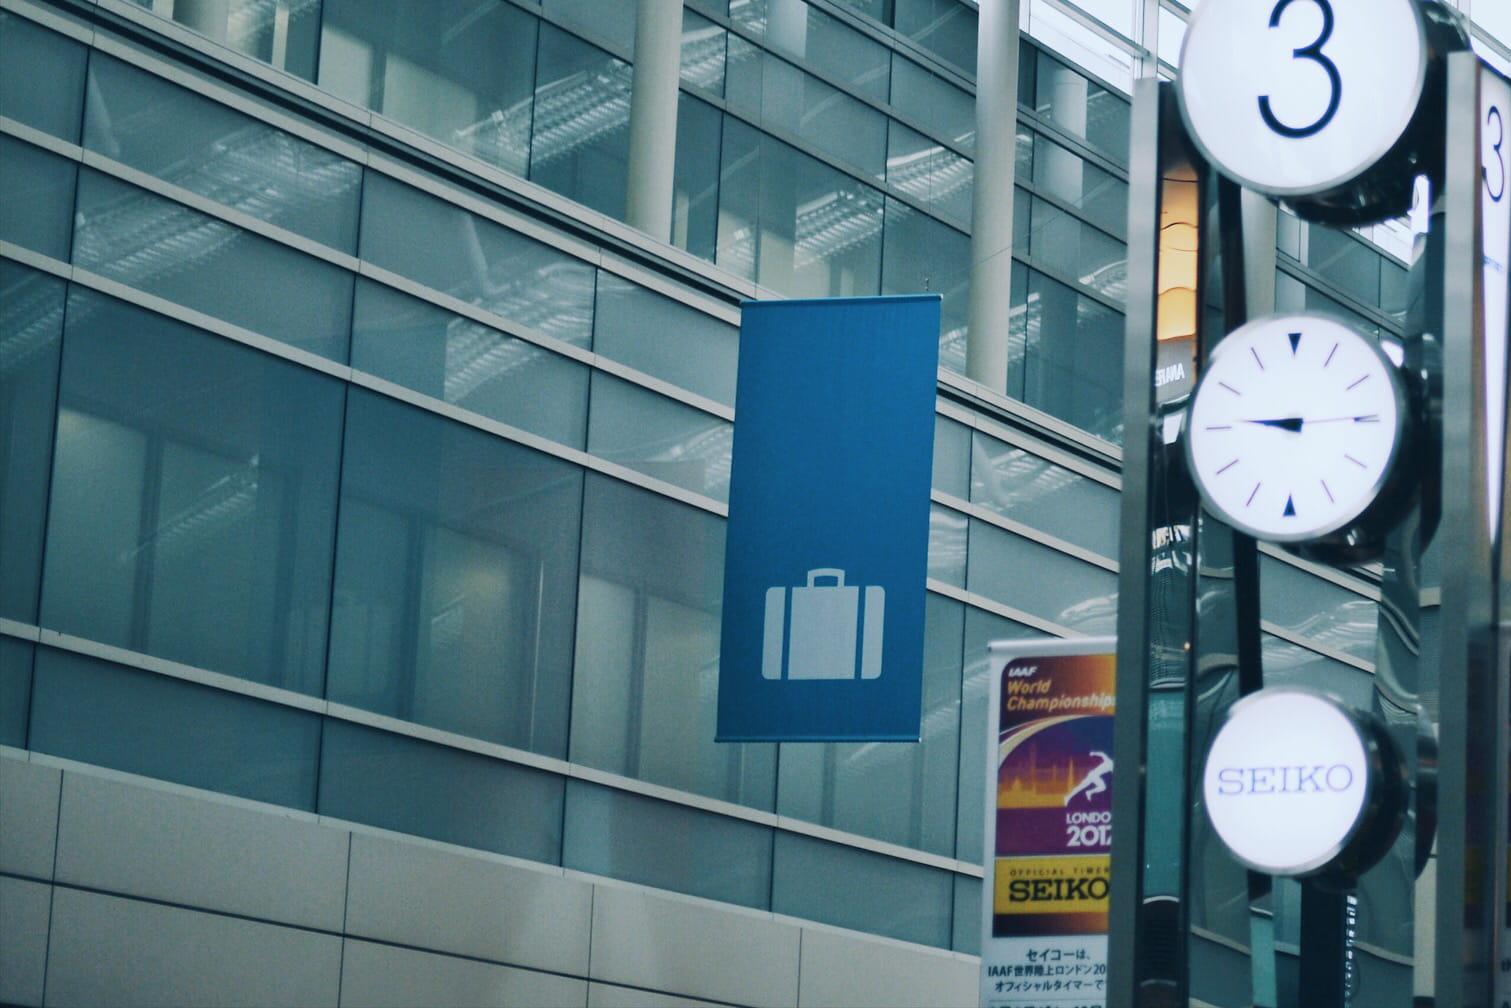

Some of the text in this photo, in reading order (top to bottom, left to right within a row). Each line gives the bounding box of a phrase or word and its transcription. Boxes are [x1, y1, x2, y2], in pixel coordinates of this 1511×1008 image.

[1481, 105, 1505, 202] 3
[1008, 666, 1038, 677] IAAF
[1007, 679, 1052, 694] World
[1007, 693, 1116, 712] Championship
[1218, 764, 1353, 795] SEIKO
[1009, 877, 1109, 902] SEIKO
